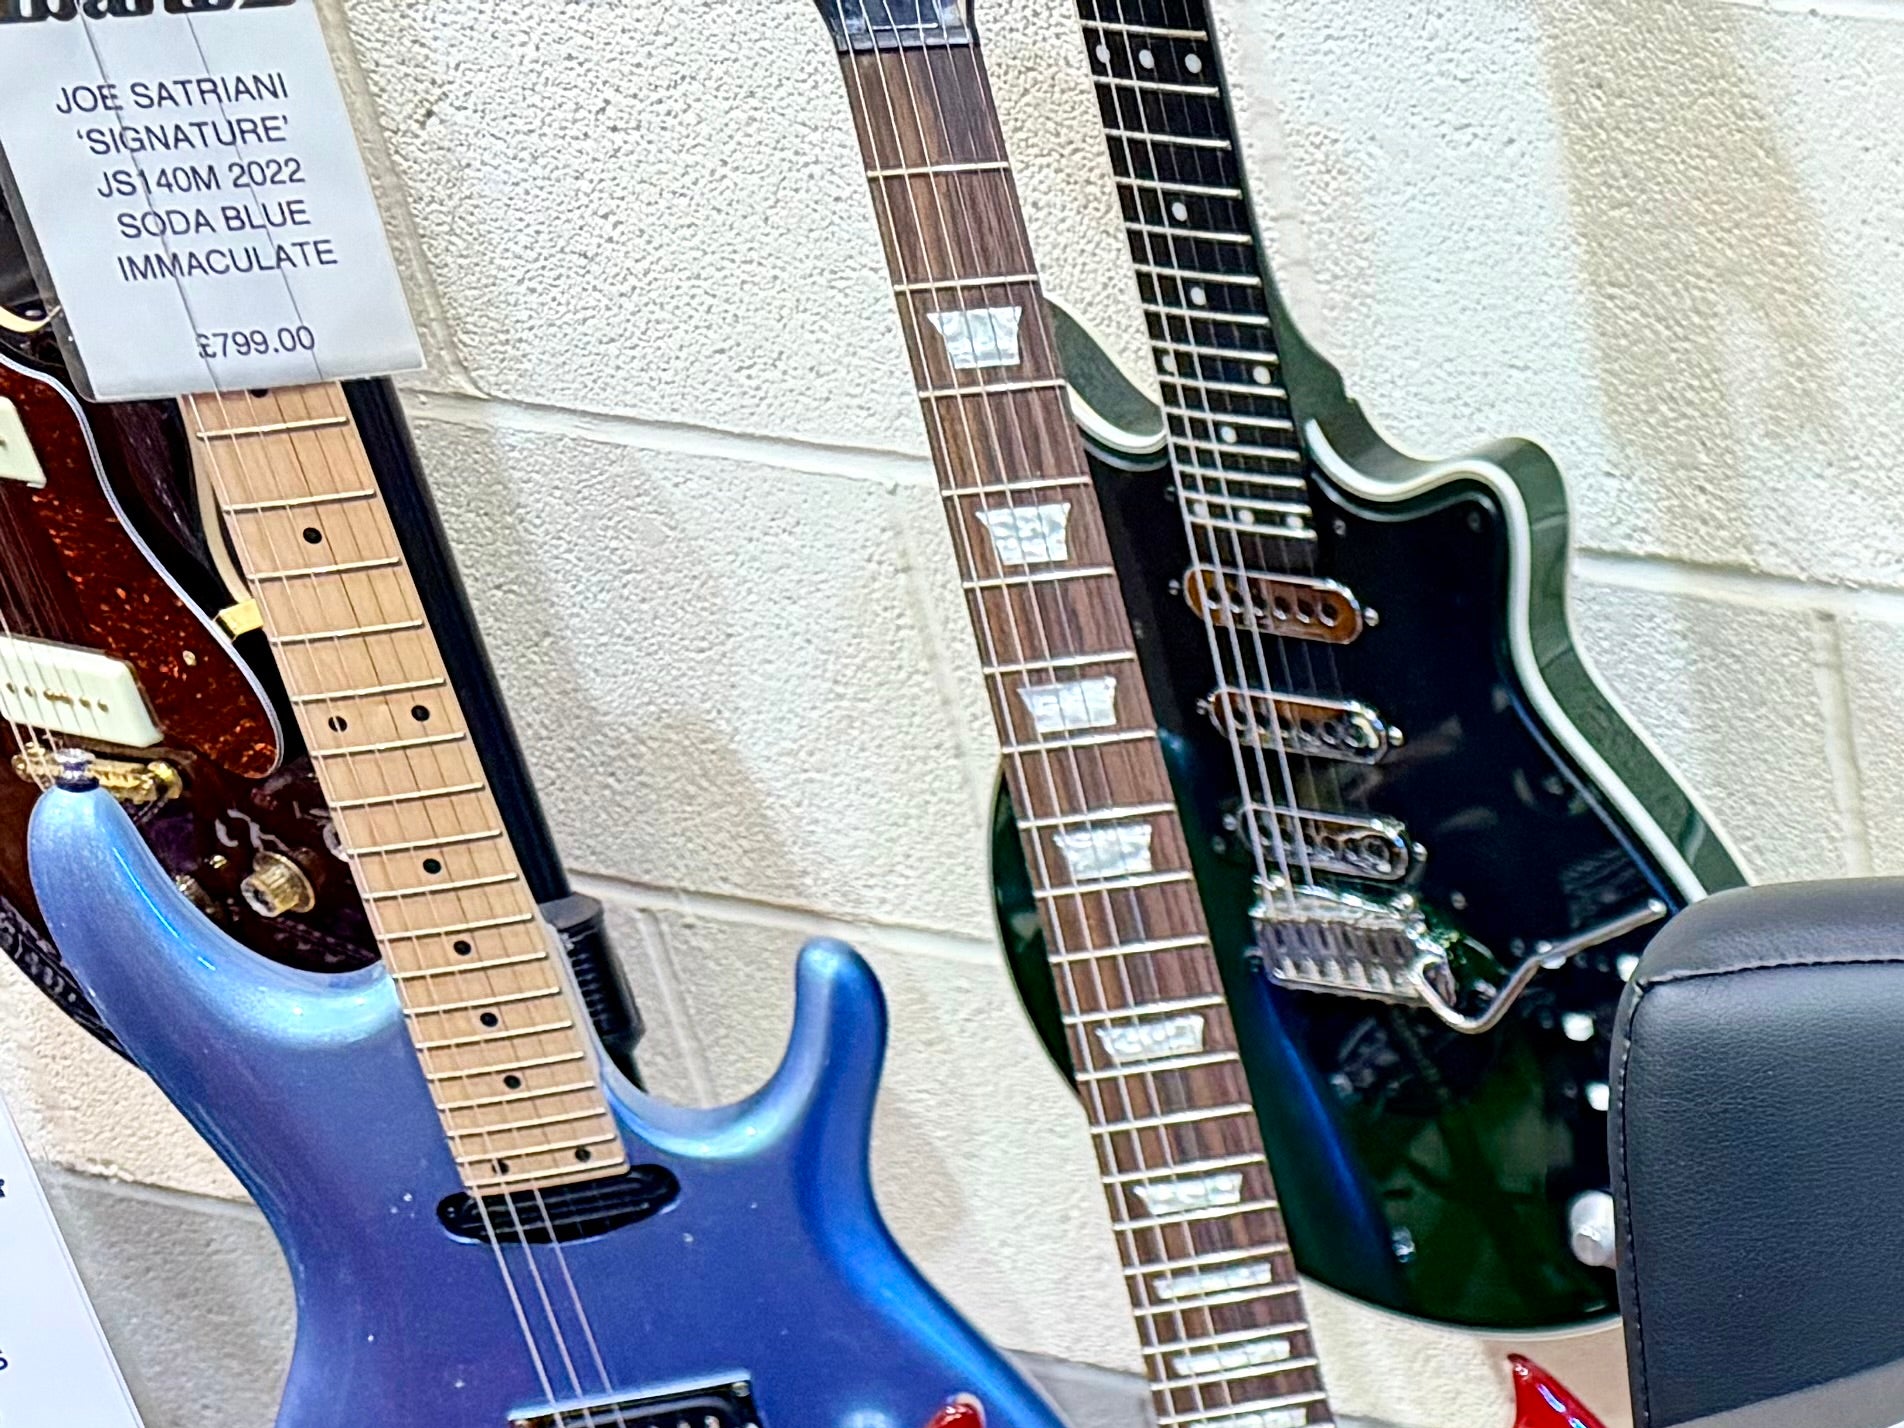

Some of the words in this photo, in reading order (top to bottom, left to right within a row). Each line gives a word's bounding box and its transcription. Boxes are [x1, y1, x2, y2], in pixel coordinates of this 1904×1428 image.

[56, 84, 123, 114] JOE
[130, 72, 289, 109] SATRIANI
[97, 164, 222, 199] JS140M
[228, 157, 306, 189] 2022
[117, 210, 216, 239] SODA
[221, 199, 311, 232] BLUE
[118, 238, 338, 282] IMMACULATE
[197, 324, 315, 360] £799.00
